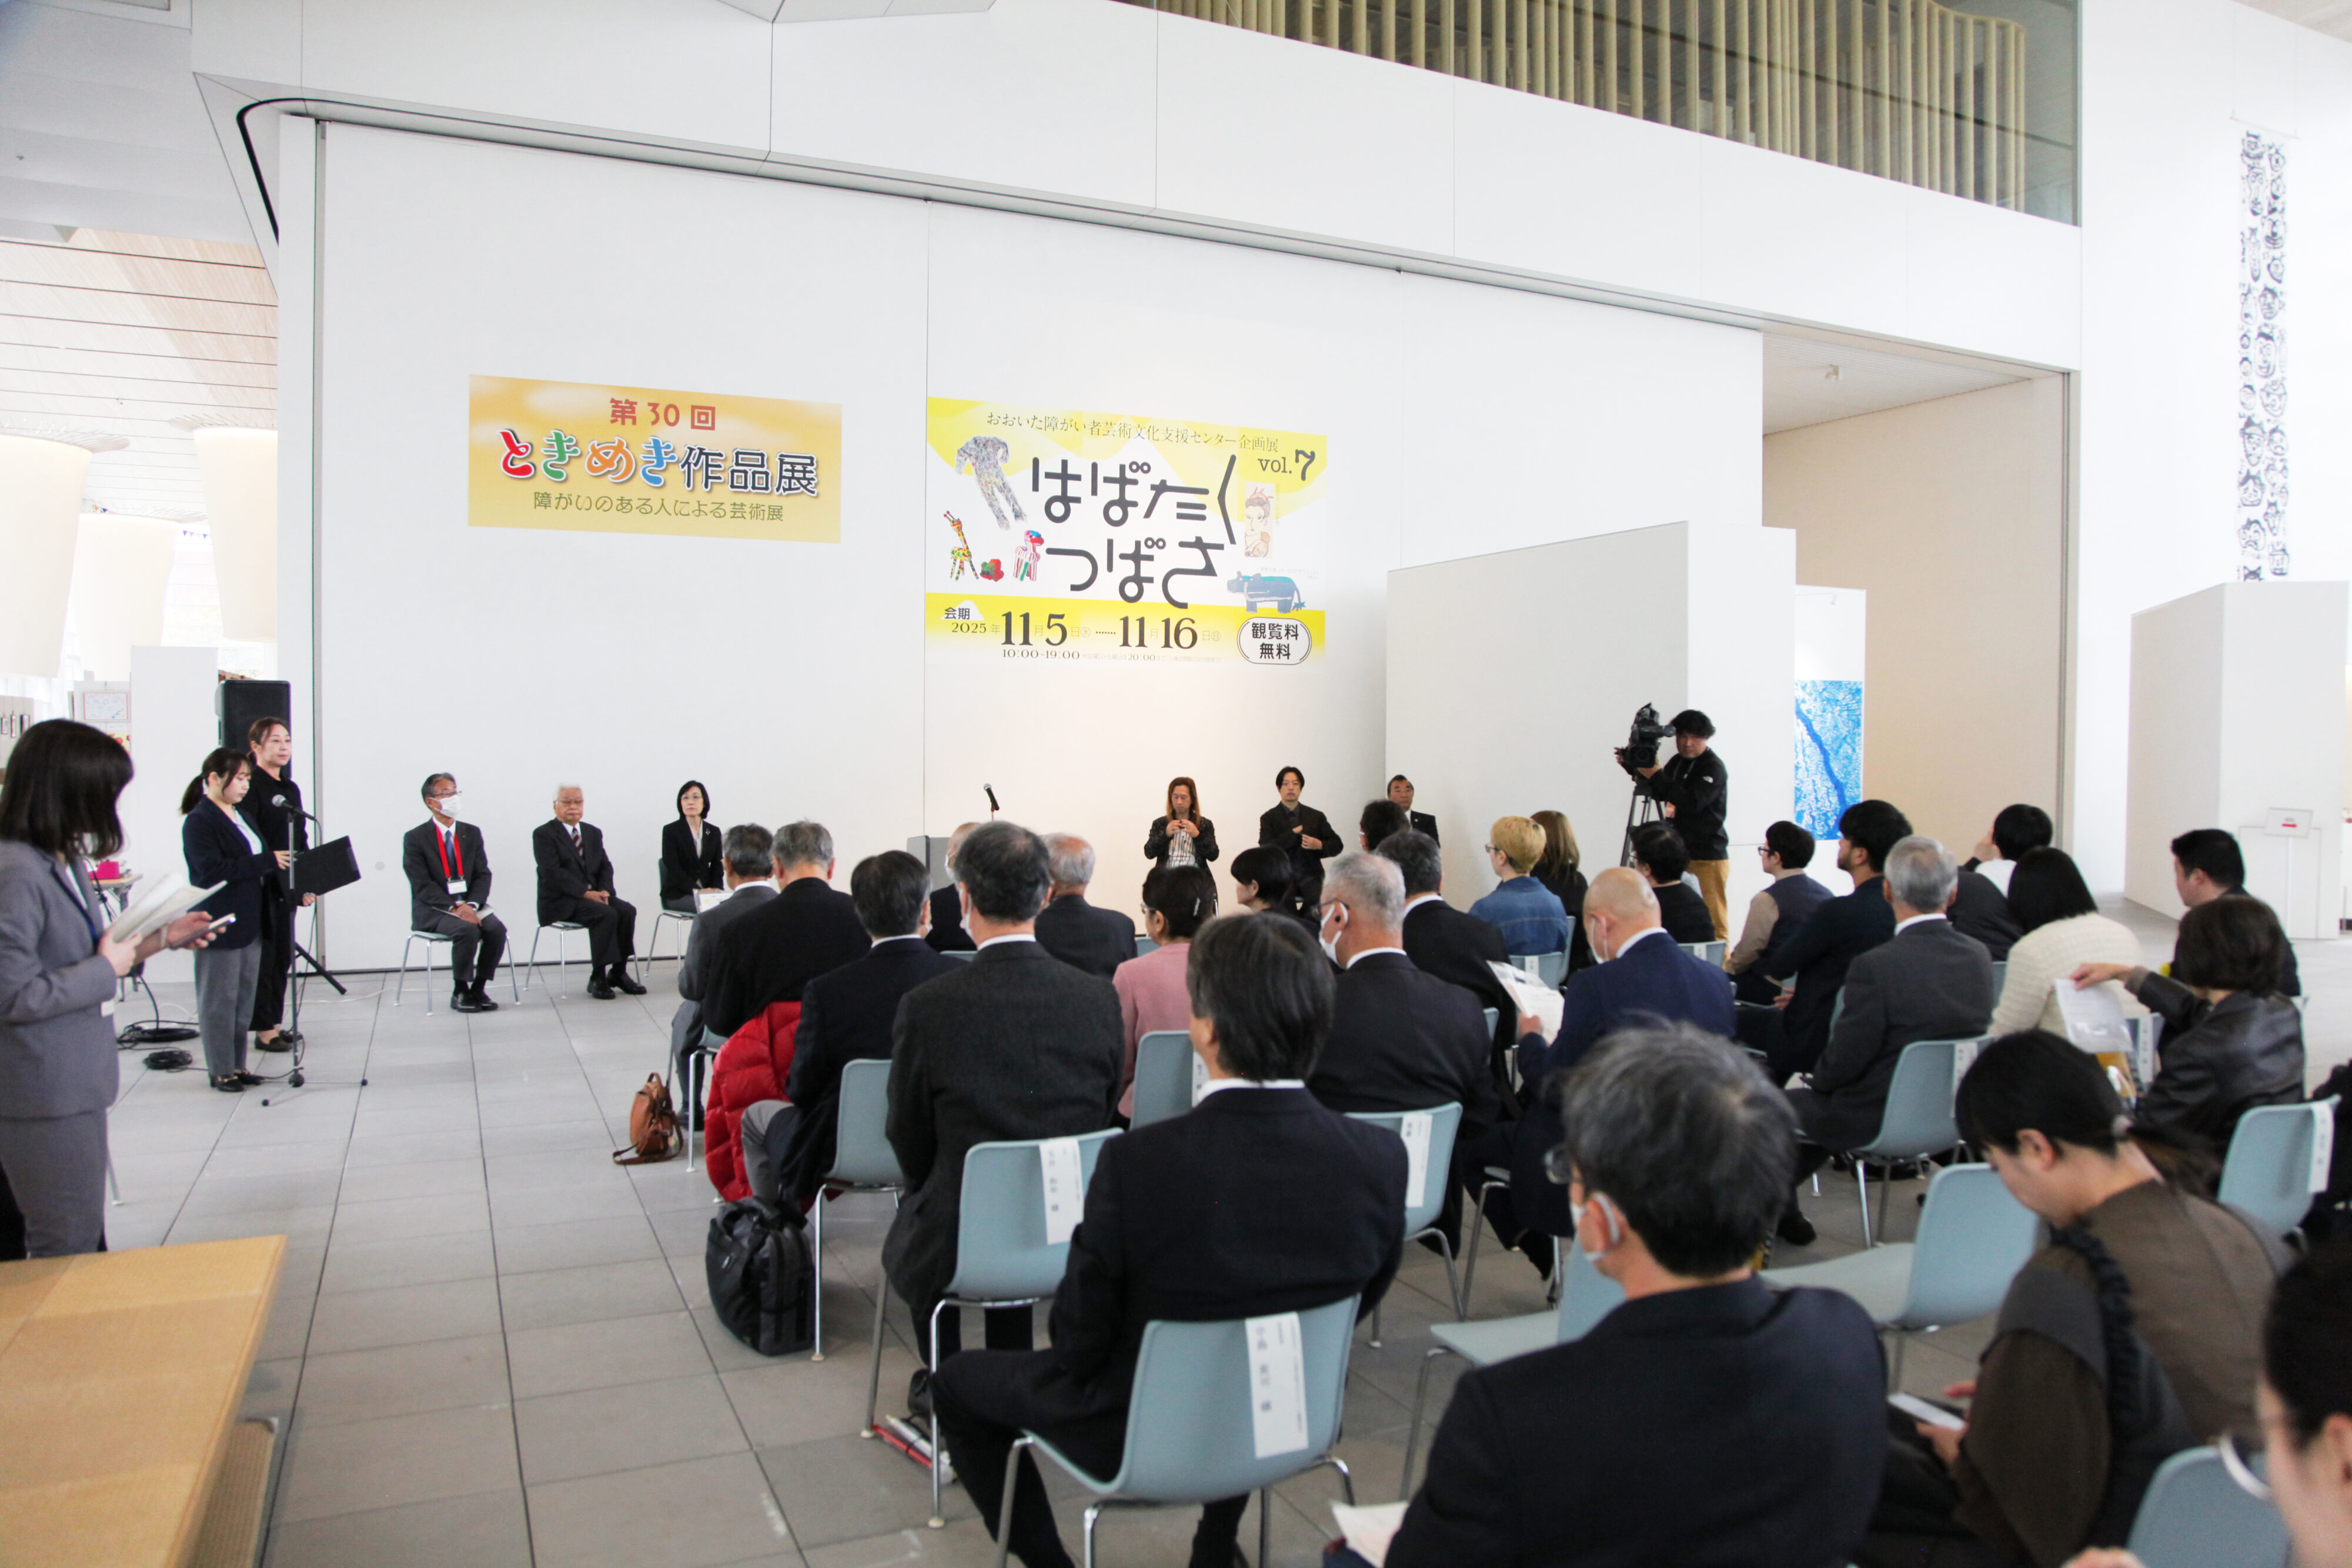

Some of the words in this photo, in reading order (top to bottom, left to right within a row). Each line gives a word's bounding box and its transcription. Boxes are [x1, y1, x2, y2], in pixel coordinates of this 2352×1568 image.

[987, 412, 1279, 452] おおいた障がい者芸術文化支援センター企画展
[497, 429, 818, 496] ときめき作品展
[533, 492, 784, 522] 障がいのある人による芸術展
[1032, 454, 1237, 544] はばたく
[1045, 536, 1224, 609] つばさ
[944, 607, 970, 620] 会期
[1252, 622, 1298, 640] 観覧料
[1259, 643, 1291, 660] 無料
